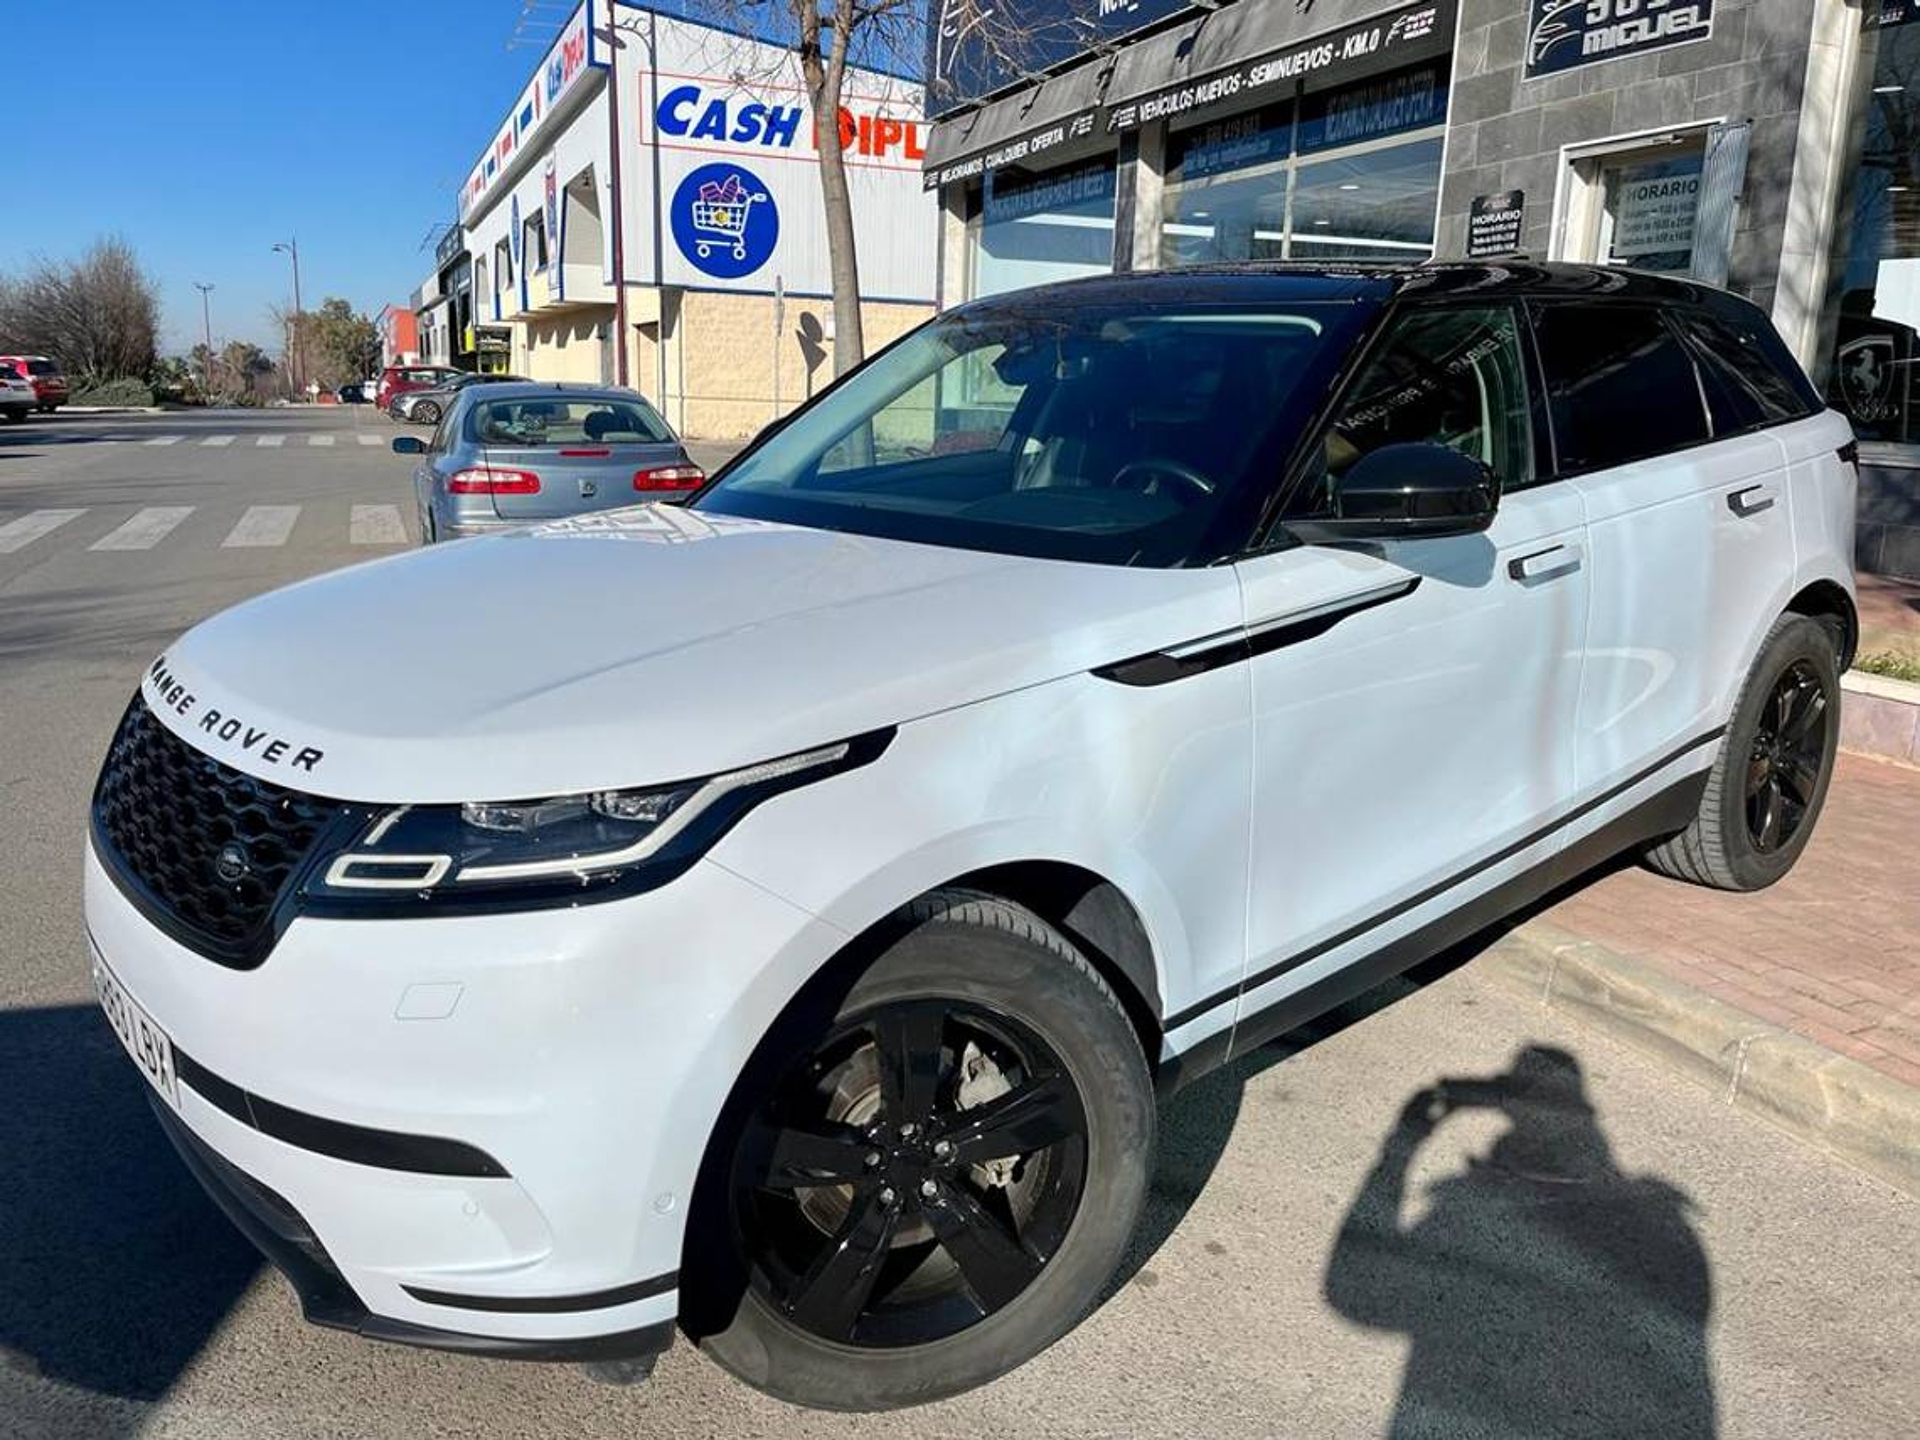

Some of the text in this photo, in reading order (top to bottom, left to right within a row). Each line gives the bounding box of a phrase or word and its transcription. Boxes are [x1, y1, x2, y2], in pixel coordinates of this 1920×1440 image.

[1582, 5, 1712, 55] MIGUEL
[1195, 73, 1241, 105] NUEVOS
[1248, 43, 1333, 87] SEMINUEVOS
[656, 85, 803, 147] CASH
[1031, 127, 1064, 152] OFERTA
[1626, 179, 1699, 201] HORARIO
[1472, 209, 1521, 226] HORARIO
[199, 709, 324, 772] ROVER
